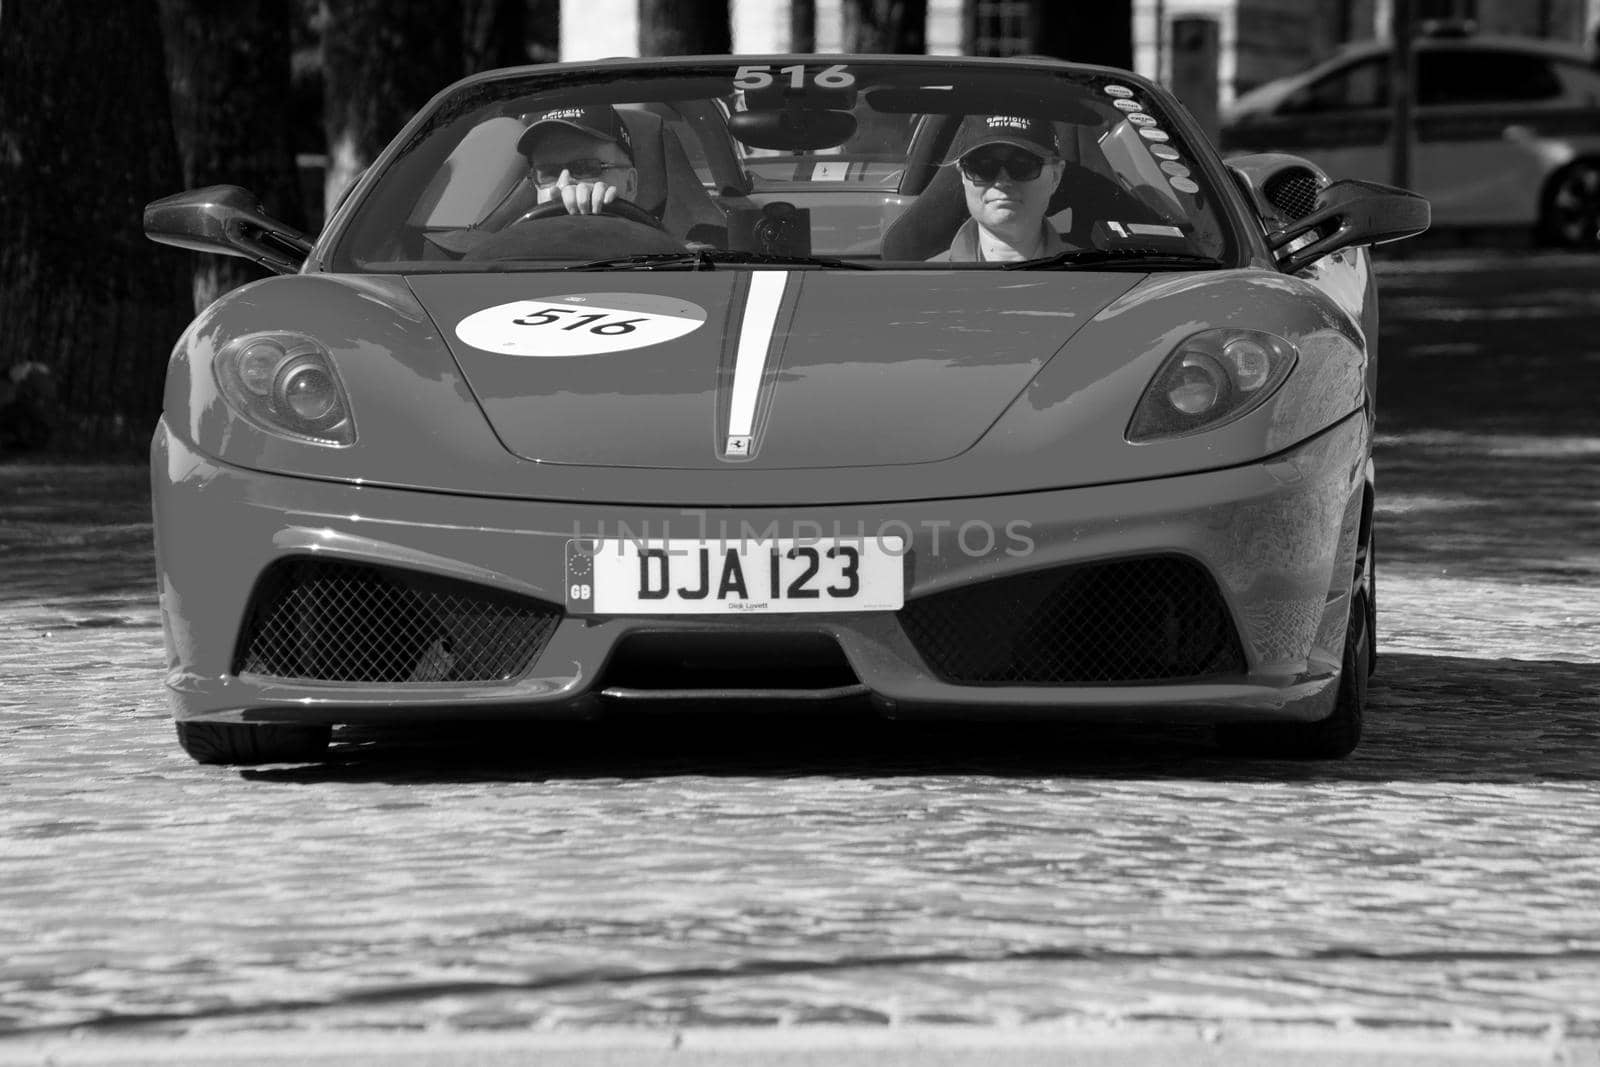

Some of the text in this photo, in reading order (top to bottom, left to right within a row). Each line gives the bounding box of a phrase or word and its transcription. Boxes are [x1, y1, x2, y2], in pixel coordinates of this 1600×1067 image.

[732, 64, 856, 89] 516
[512, 308, 650, 335] 516
[638, 546, 859, 599] DJA 123
[570, 584, 591, 600] GB
